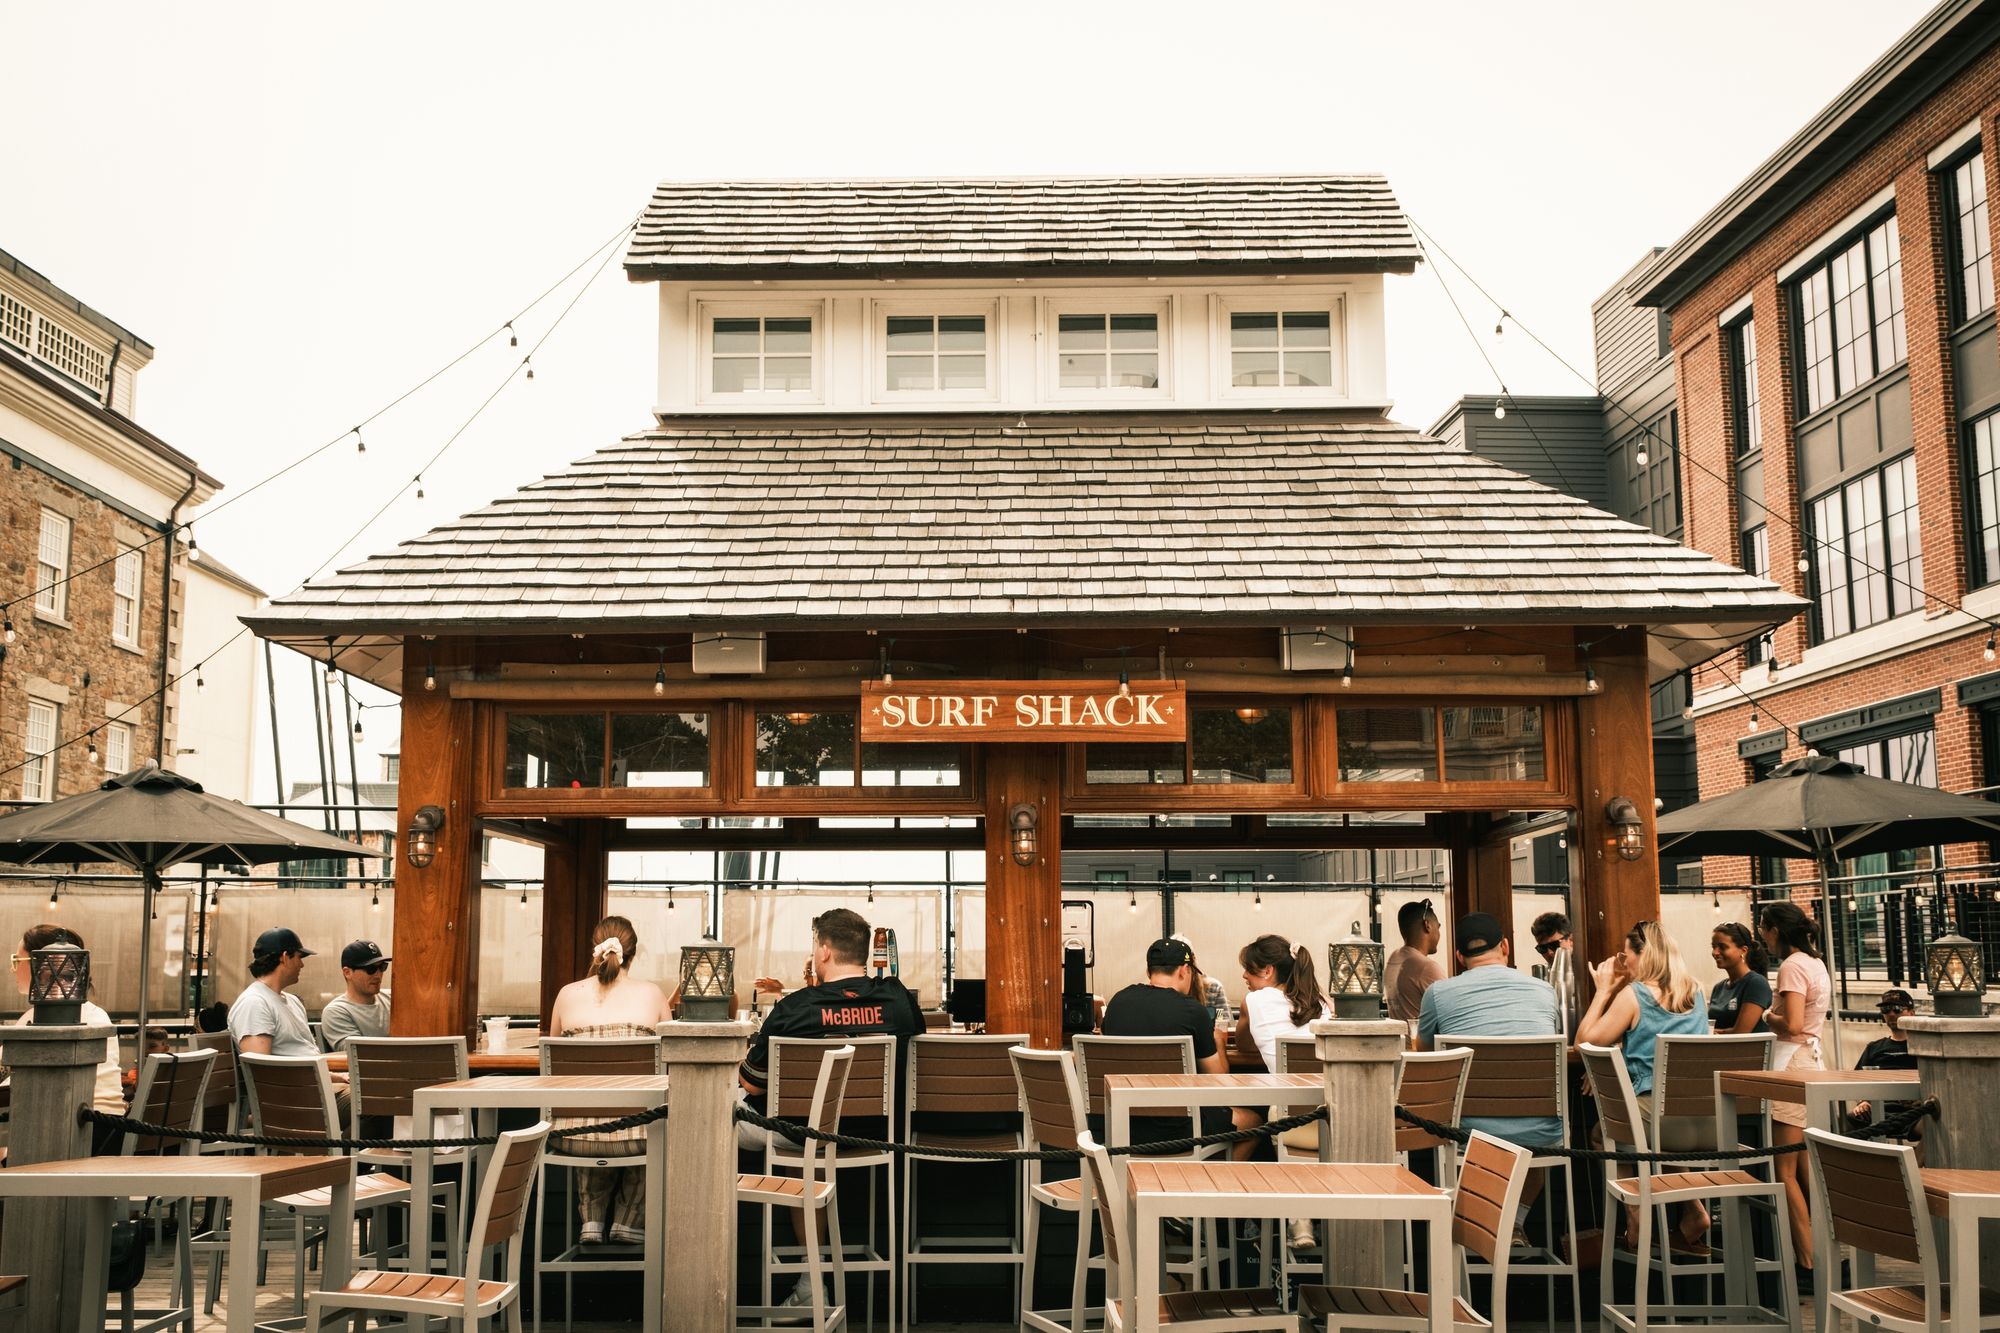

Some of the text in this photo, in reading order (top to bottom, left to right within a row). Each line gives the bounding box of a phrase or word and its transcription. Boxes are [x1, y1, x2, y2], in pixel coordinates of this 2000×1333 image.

[881, 694, 1167, 727] SURF SHACK
[821, 1006, 884, 1025] McBRIDE
